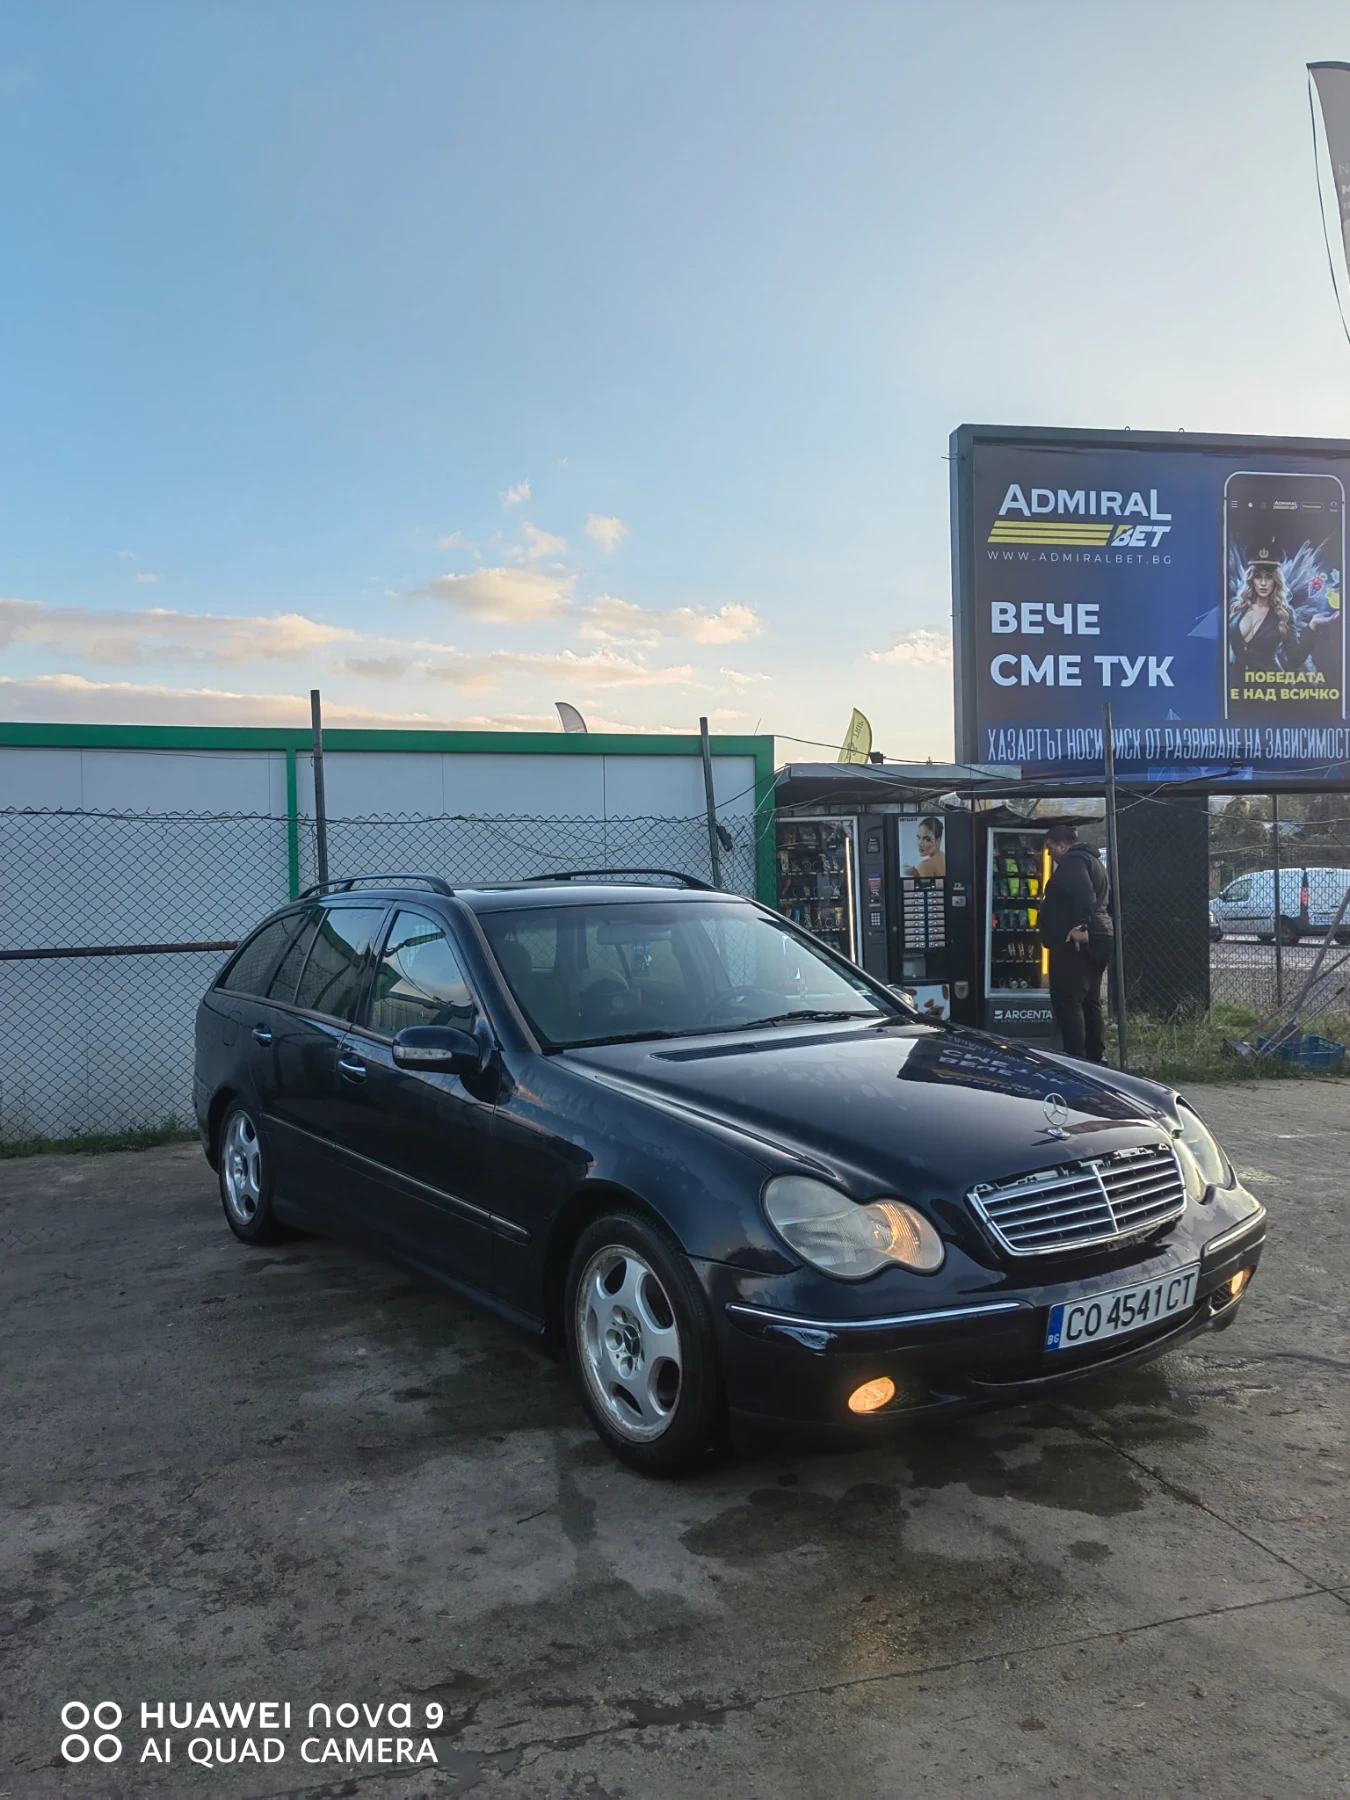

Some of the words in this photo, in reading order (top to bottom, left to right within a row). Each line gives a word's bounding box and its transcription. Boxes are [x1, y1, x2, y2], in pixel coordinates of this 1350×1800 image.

[998, 484, 1172, 521] ADMIRAL
[1111, 525, 1172, 548] BET
[987, 550, 1172, 565] WWW.ADMIRALBET.BG
[991, 601, 1100, 635] ВЕЧЕ
[990, 653, 1082, 687] СМЕ
[1094, 655, 1175, 687] ТУК
[1245, 671, 1326, 685] ПОБЕДАТА
[1230, 688, 1240, 700] Е
[1243, 688, 1277, 702] НАД
[1280, 688, 1340, 700] ВСИЧКО
[987, 728, 1063, 761] ХАЗАРТЪТ
[1066, 728, 1106, 760] НОСИ
[1145, 727, 1162, 760] ОТ
[1164, 728, 1241, 760] РАЗВИВАНЕ
[1244, 728, 1262, 759] НА
[1265, 727, 1350, 759] ЗАВИСИМОСТ
[1004, 1009, 1053, 1020] ARGENTA
[1047, 1333, 1060, 1346] BG
[1066, 1302, 1102, 1341] CO
[1106, 1284, 1163, 1331] 4541
[1166, 1272, 1196, 1312] CT
